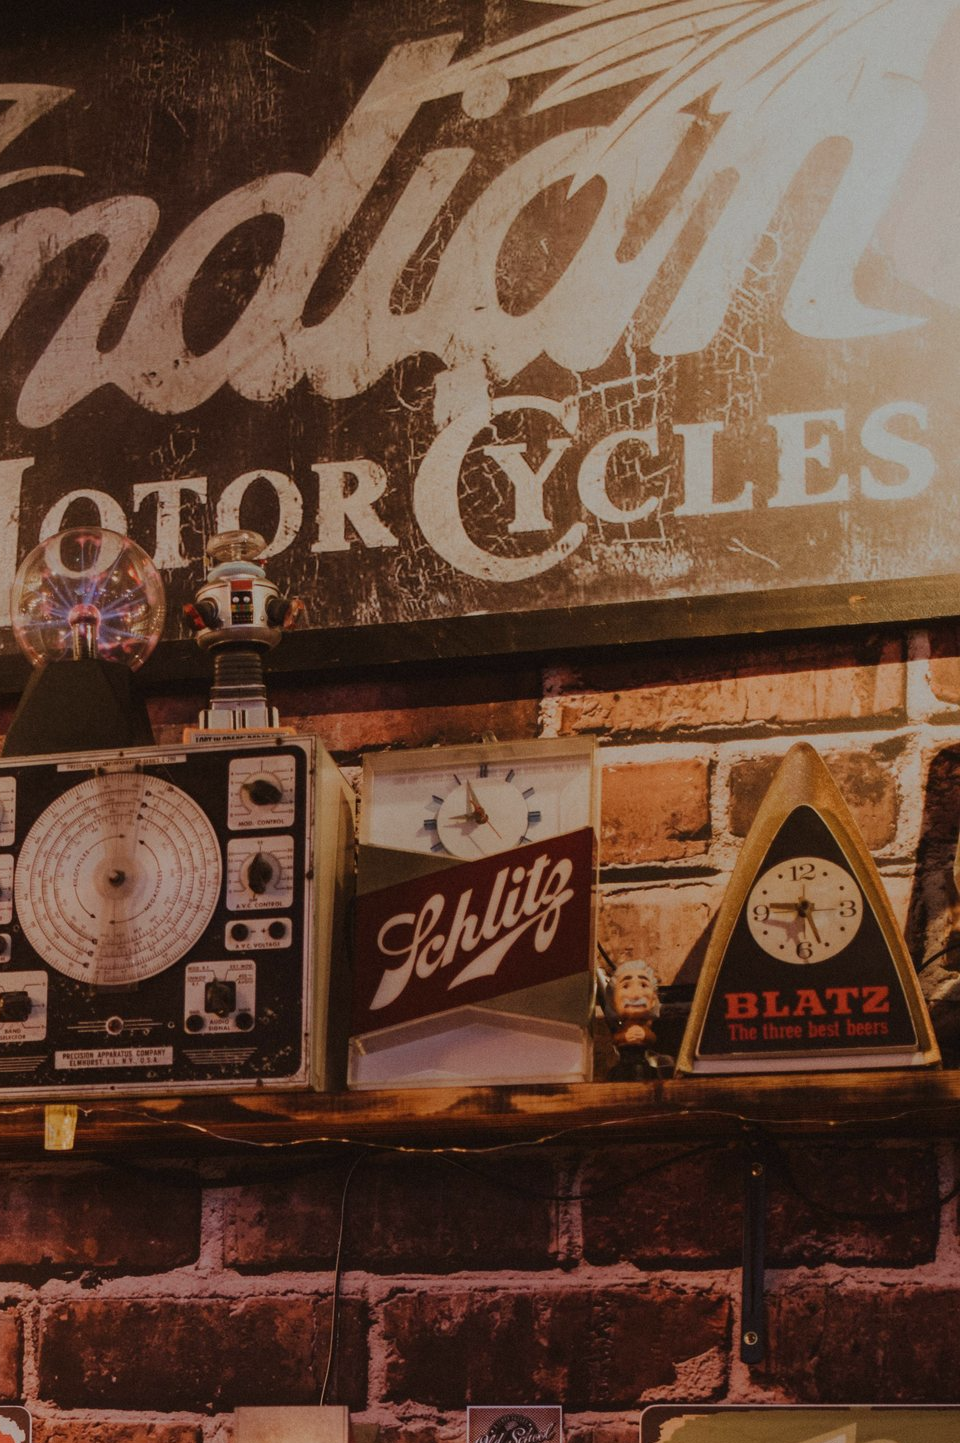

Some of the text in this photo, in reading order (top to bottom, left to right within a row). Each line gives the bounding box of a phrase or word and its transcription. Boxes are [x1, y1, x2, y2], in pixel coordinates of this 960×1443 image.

[790, 863, 816, 881] 12
[753, 904, 770, 921] 9
[840, 900, 857, 917] 3
[369, 854, 575, 1010] Schlitz
[796, 942, 813, 959] 6
[724, 986, 890, 1019] BLATZ
[729, 1017, 889, 1041] The three best beers
[136, 1049, 166, 1057] COMPANY
